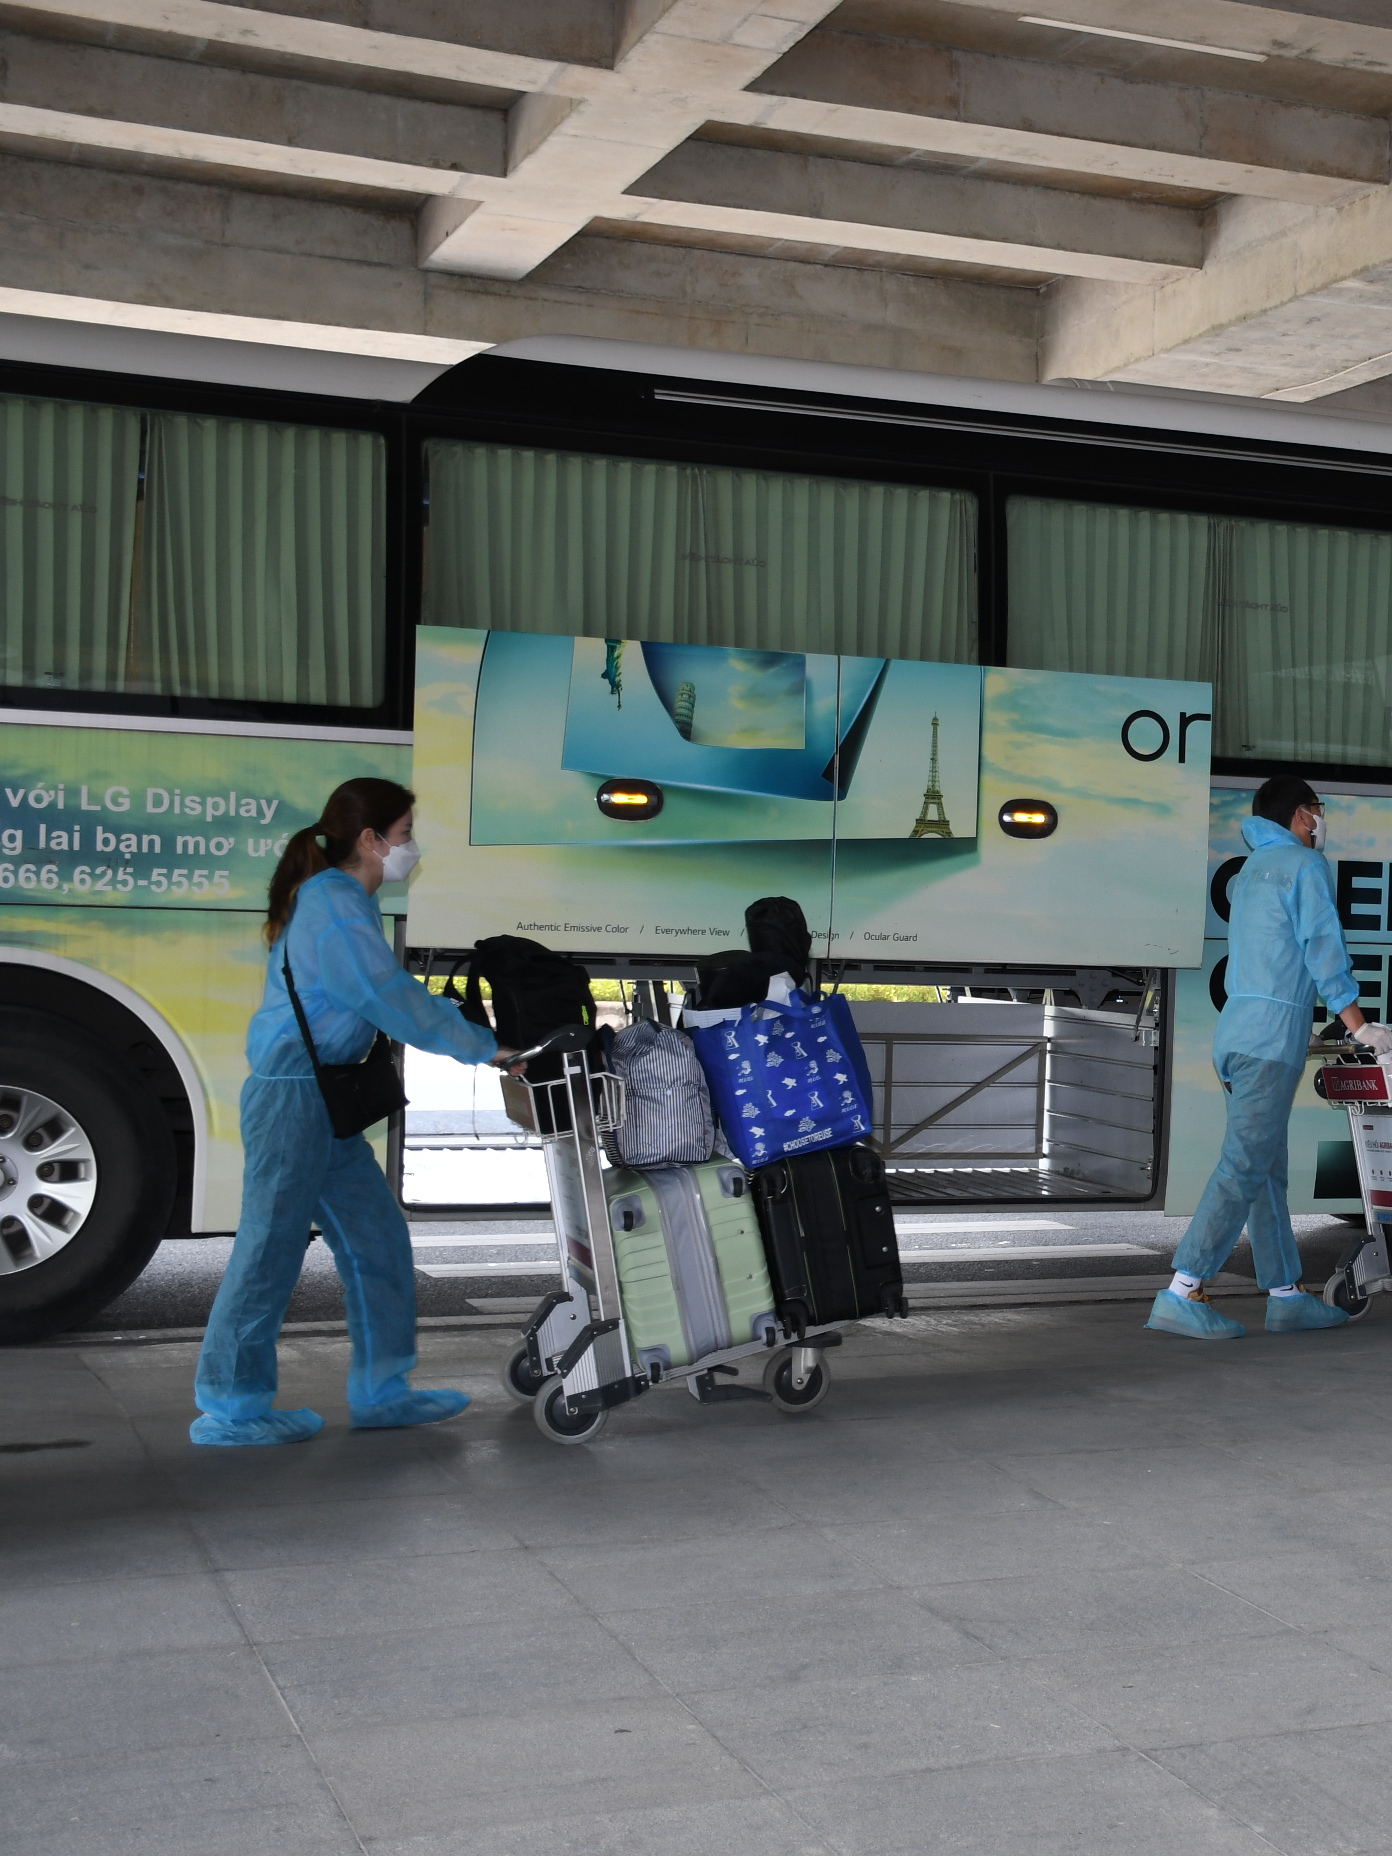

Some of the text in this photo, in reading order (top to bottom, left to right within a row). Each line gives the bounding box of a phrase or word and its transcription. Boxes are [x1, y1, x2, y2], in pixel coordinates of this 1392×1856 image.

[4, 782, 279, 825] với LG Display
[39, 824, 81, 851] lai
[96, 826, 162, 859] bạn
[176, 835, 235, 856] mơ
[516, 921, 562, 932] Authentic
[563, 922, 603, 933] Emissive
[604, 924, 630, 934] Color
[654, 926, 707, 938] Everywhere
[709, 928, 731, 937] View
[811, 930, 840, 941] Design
[863, 931, 891, 941] Ocular
[892, 933, 918, 942] Guard
[1340, 1079, 1379, 1091] AGRIBANK
[783, 1127, 833, 1152] #CHOOSETOREUSE
